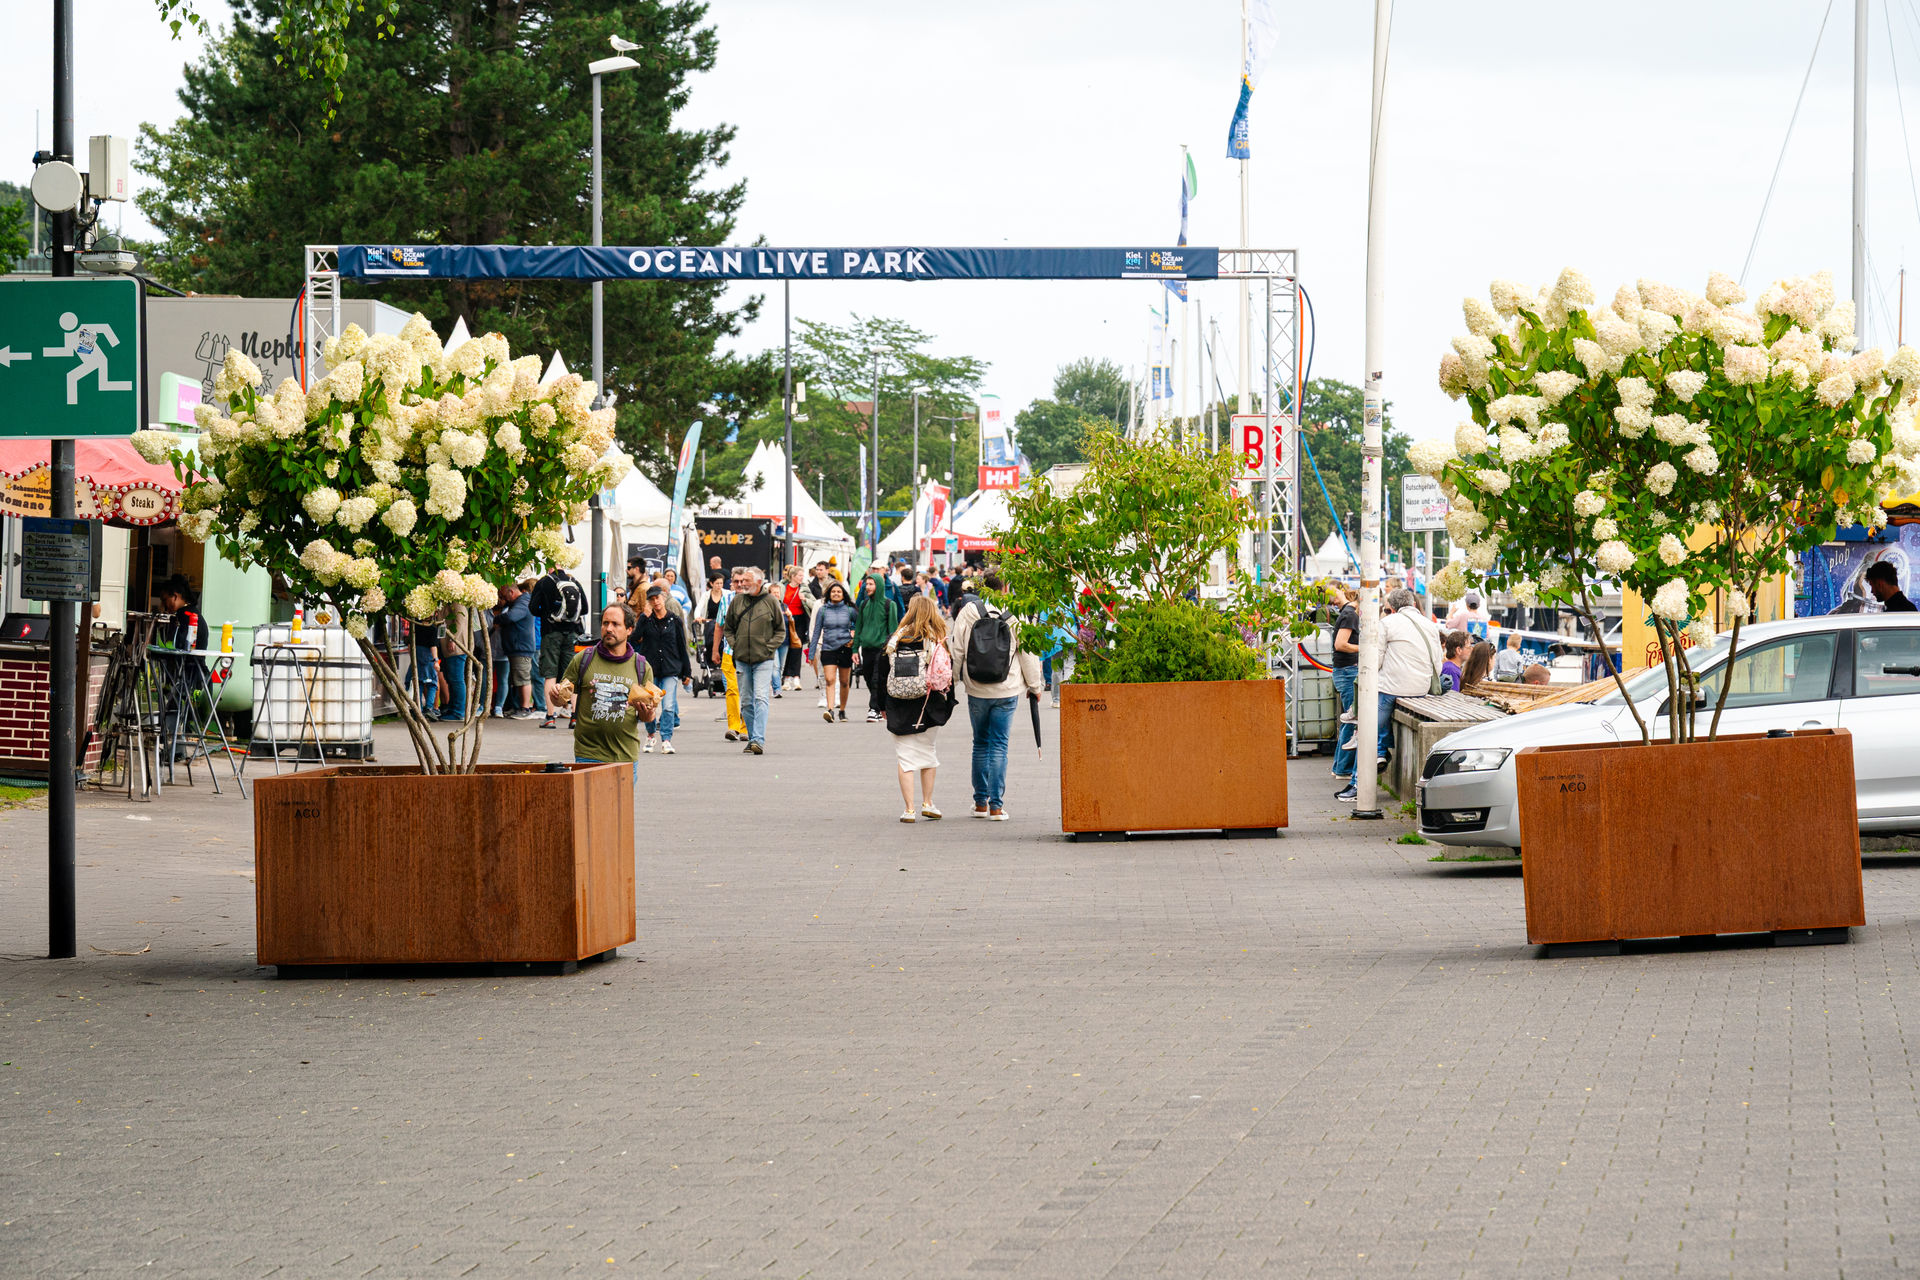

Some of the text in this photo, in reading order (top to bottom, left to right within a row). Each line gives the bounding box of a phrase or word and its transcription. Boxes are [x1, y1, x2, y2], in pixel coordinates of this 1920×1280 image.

[628, 250, 926, 274] OCEAN LIVE PARK
[985, 470, 1013, 486] HH
[131, 496, 155, 509] Steaks
[1560, 782, 1586, 792] ACO
[294, 808, 320, 818] ACO
